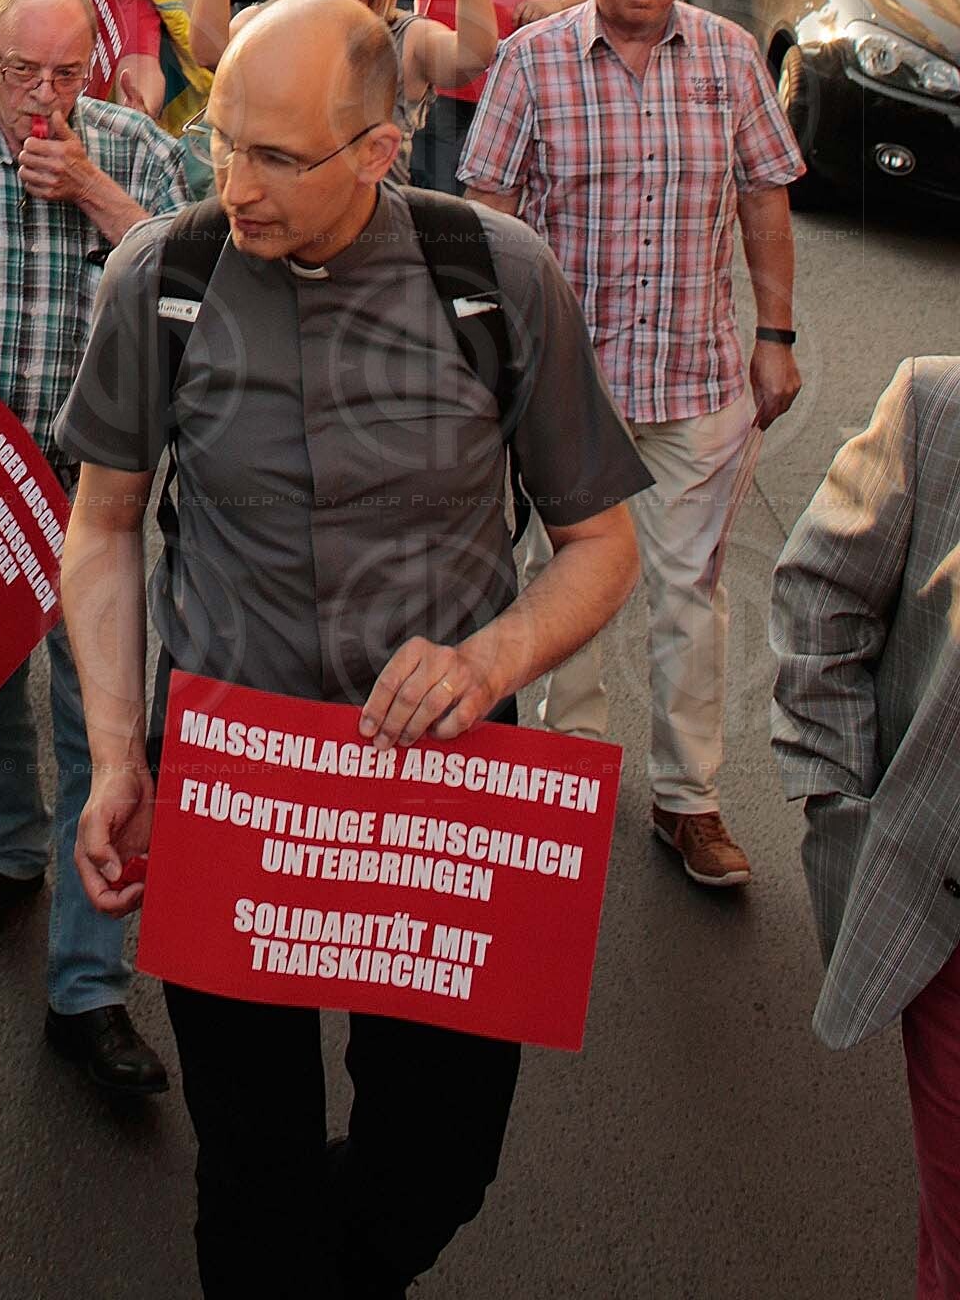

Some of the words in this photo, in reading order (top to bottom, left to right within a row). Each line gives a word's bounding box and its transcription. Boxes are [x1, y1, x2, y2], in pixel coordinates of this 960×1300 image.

[180, 709, 397, 780] MASSENLAGER
[401, 748, 600, 814] ABSCHAFFEN
[180, 779, 376, 844] FLÜCHTLINGE
[380, 812, 583, 880] MENSCHLICH
[261, 838, 493, 902] UNTERBRINGEN
[233, 899, 427, 954] SOLIDARITÄT
[431, 925, 492, 968] MIT
[250, 938, 473, 1000] TRAISKIRCHEN
